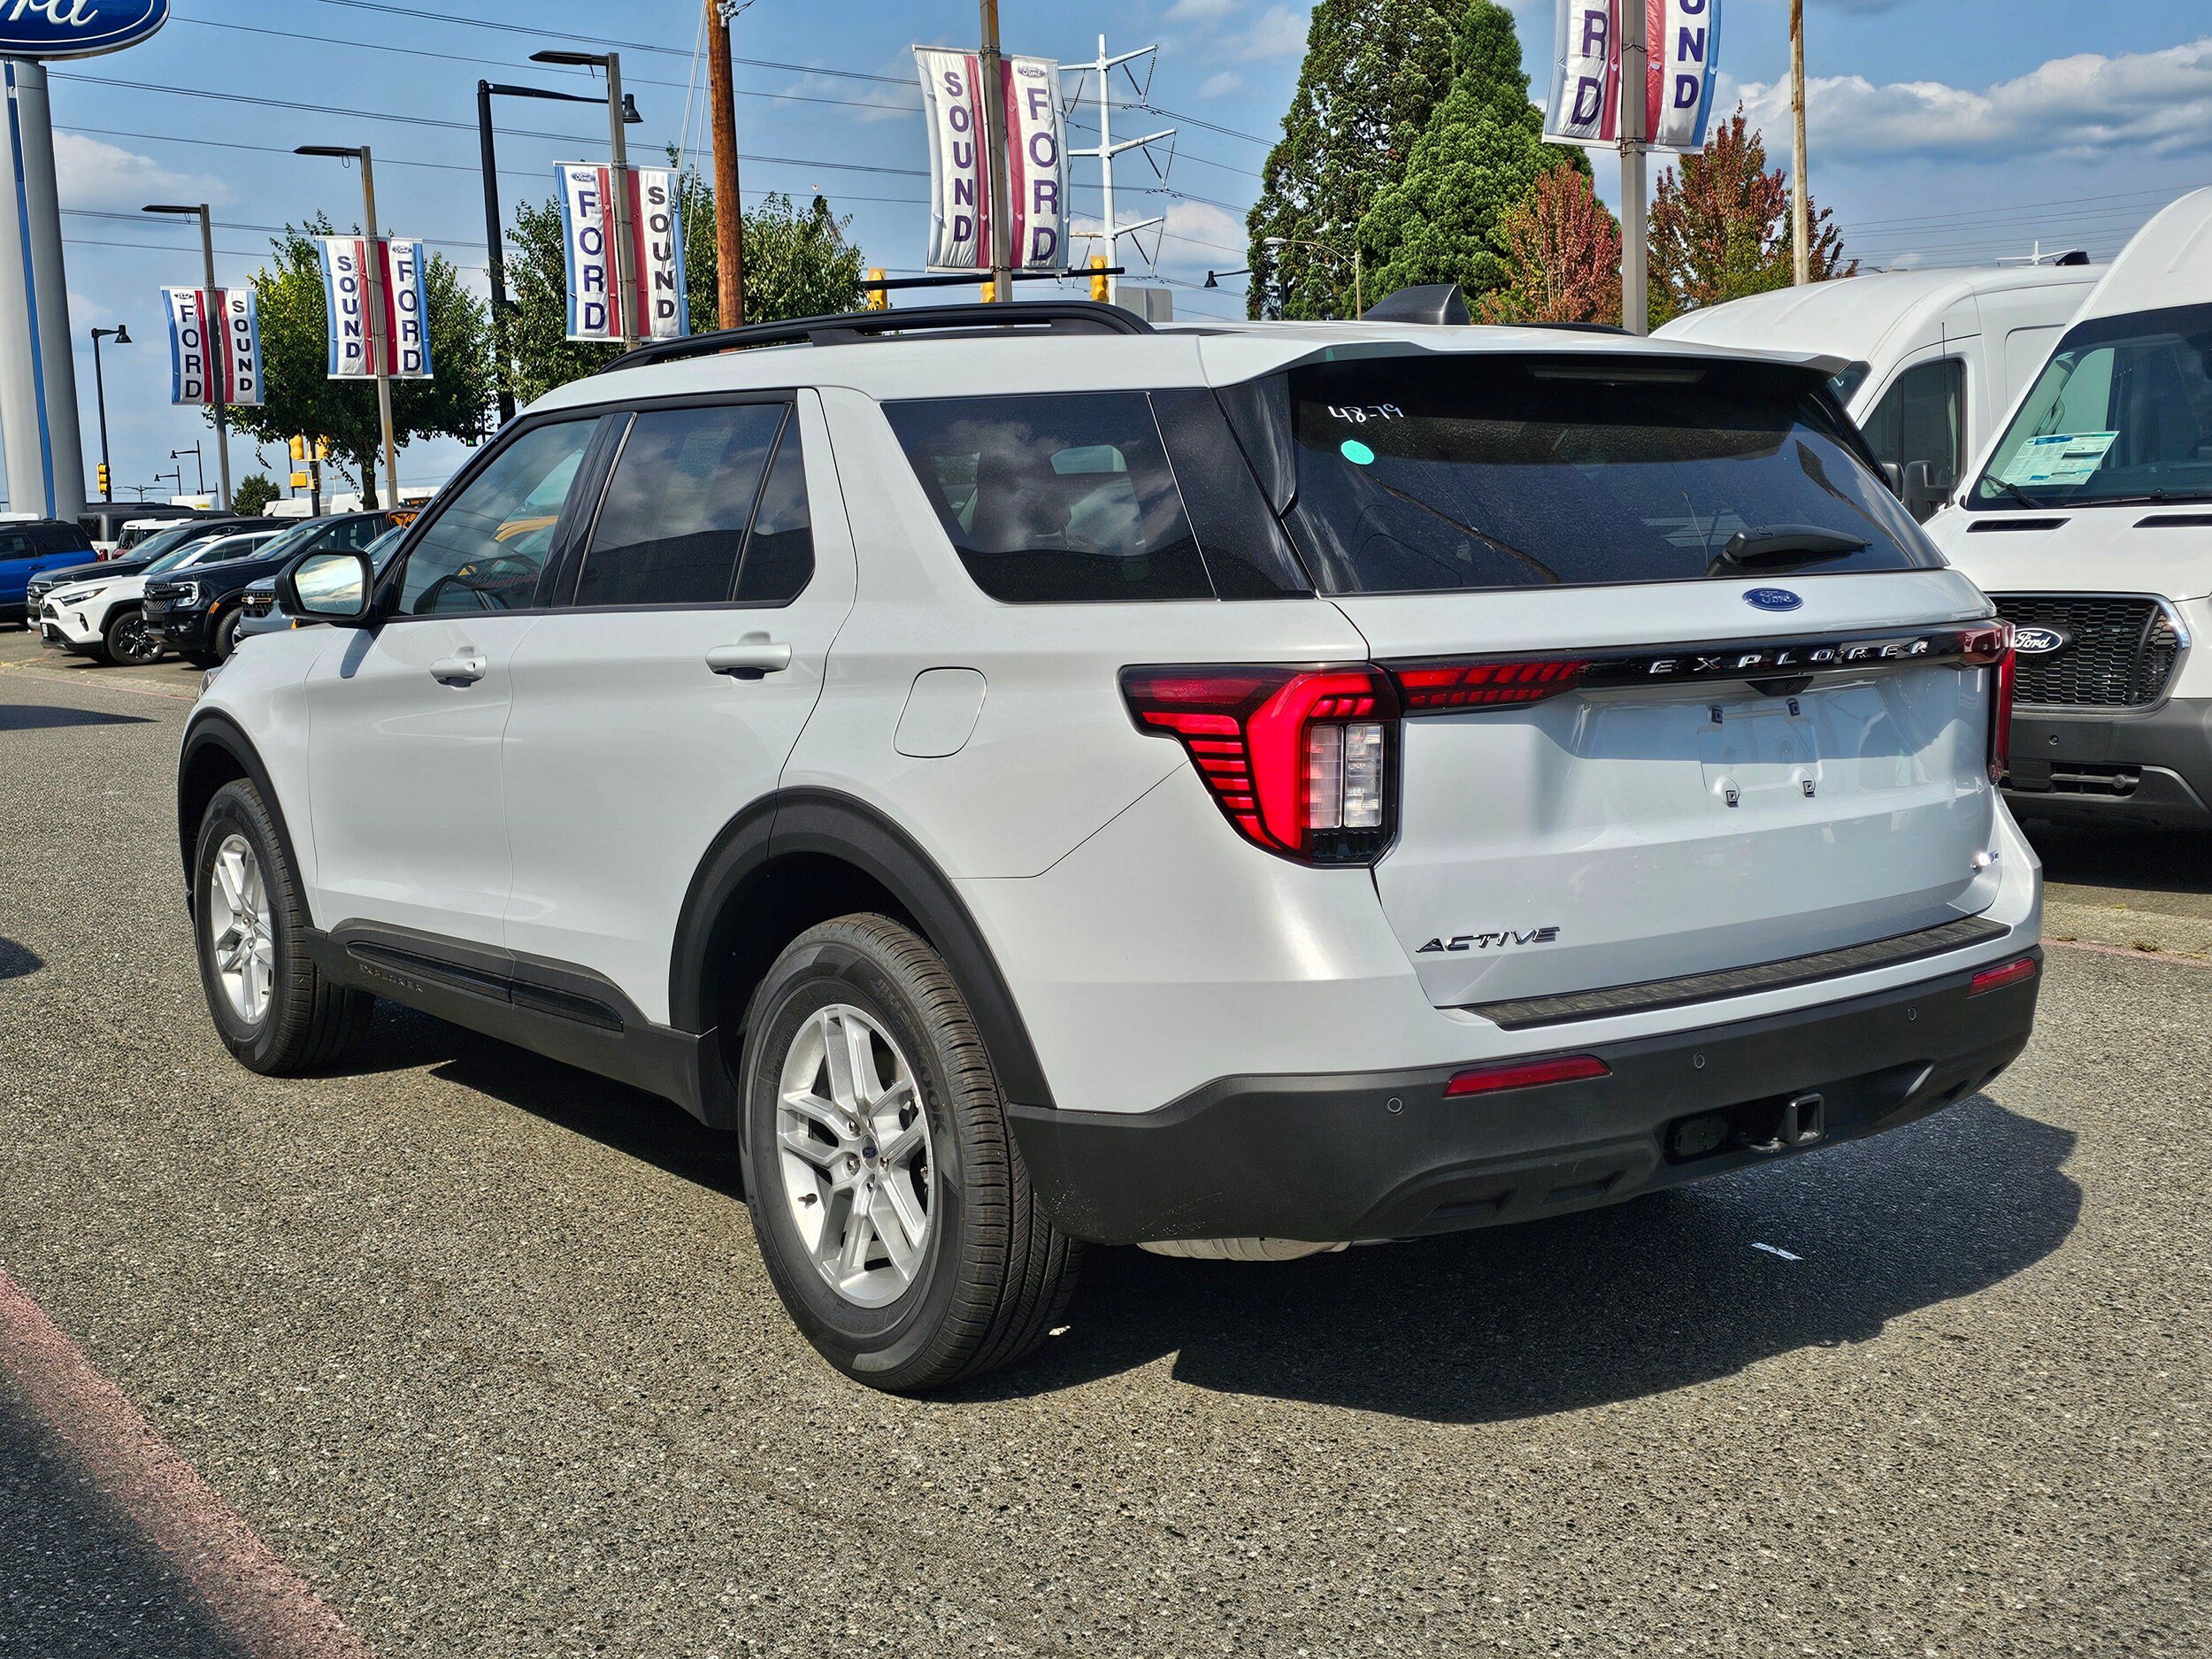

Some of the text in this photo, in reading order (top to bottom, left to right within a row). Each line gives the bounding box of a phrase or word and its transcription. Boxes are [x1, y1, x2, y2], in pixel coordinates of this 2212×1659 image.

[1571, 9, 1608, 126] RD
[943, 71, 973, 242] SOUND
[1026, 87, 1058, 262] FORD
[578, 190, 606, 330] FORD
[648, 186, 675, 319] SOUND
[180, 304, 203, 398] FORD
[233, 300, 253, 391] SOUND
[337, 255, 360, 358] SOUND
[397, 260, 421, 372] FORD
[1648, 640, 1930, 675] EXPLORER
[2015, 631, 2052, 649] Ford
[1415, 926, 1561, 954] ACTIVE
